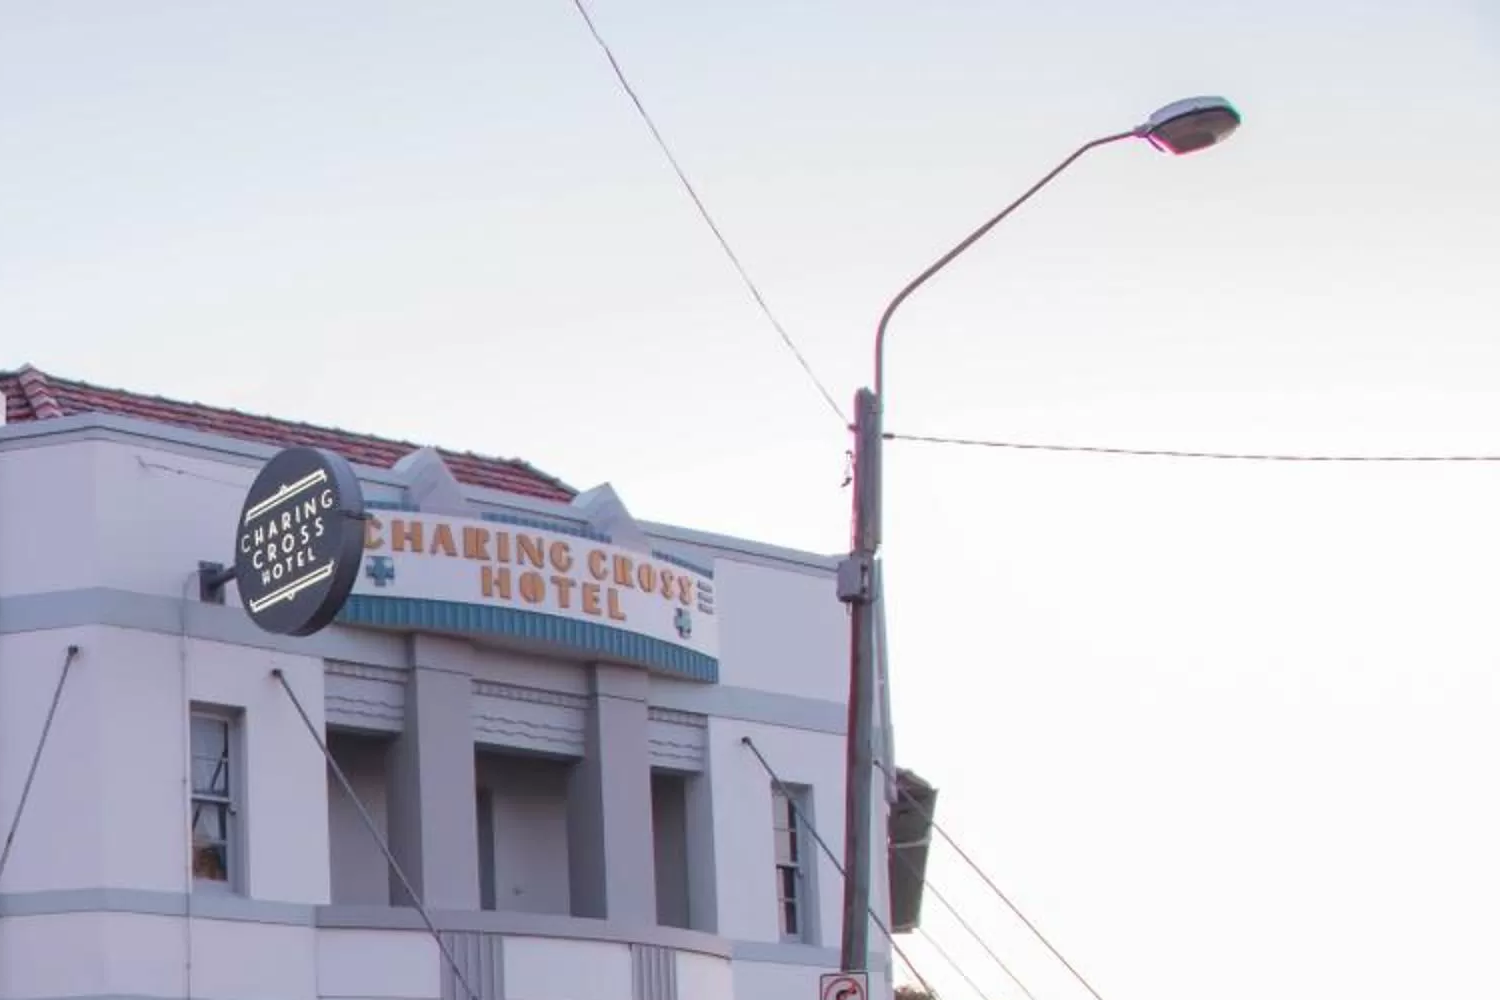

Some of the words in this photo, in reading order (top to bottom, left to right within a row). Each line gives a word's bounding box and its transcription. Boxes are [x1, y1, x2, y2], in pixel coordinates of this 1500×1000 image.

[241, 489, 333, 553] CHARING
[253, 517, 324, 569] CROSS
[262, 547, 316, 586] HOTEL
[364, 518, 574, 573] CHARING
[587, 548, 694, 606] CROSS
[481, 565, 626, 621] HOTEL
